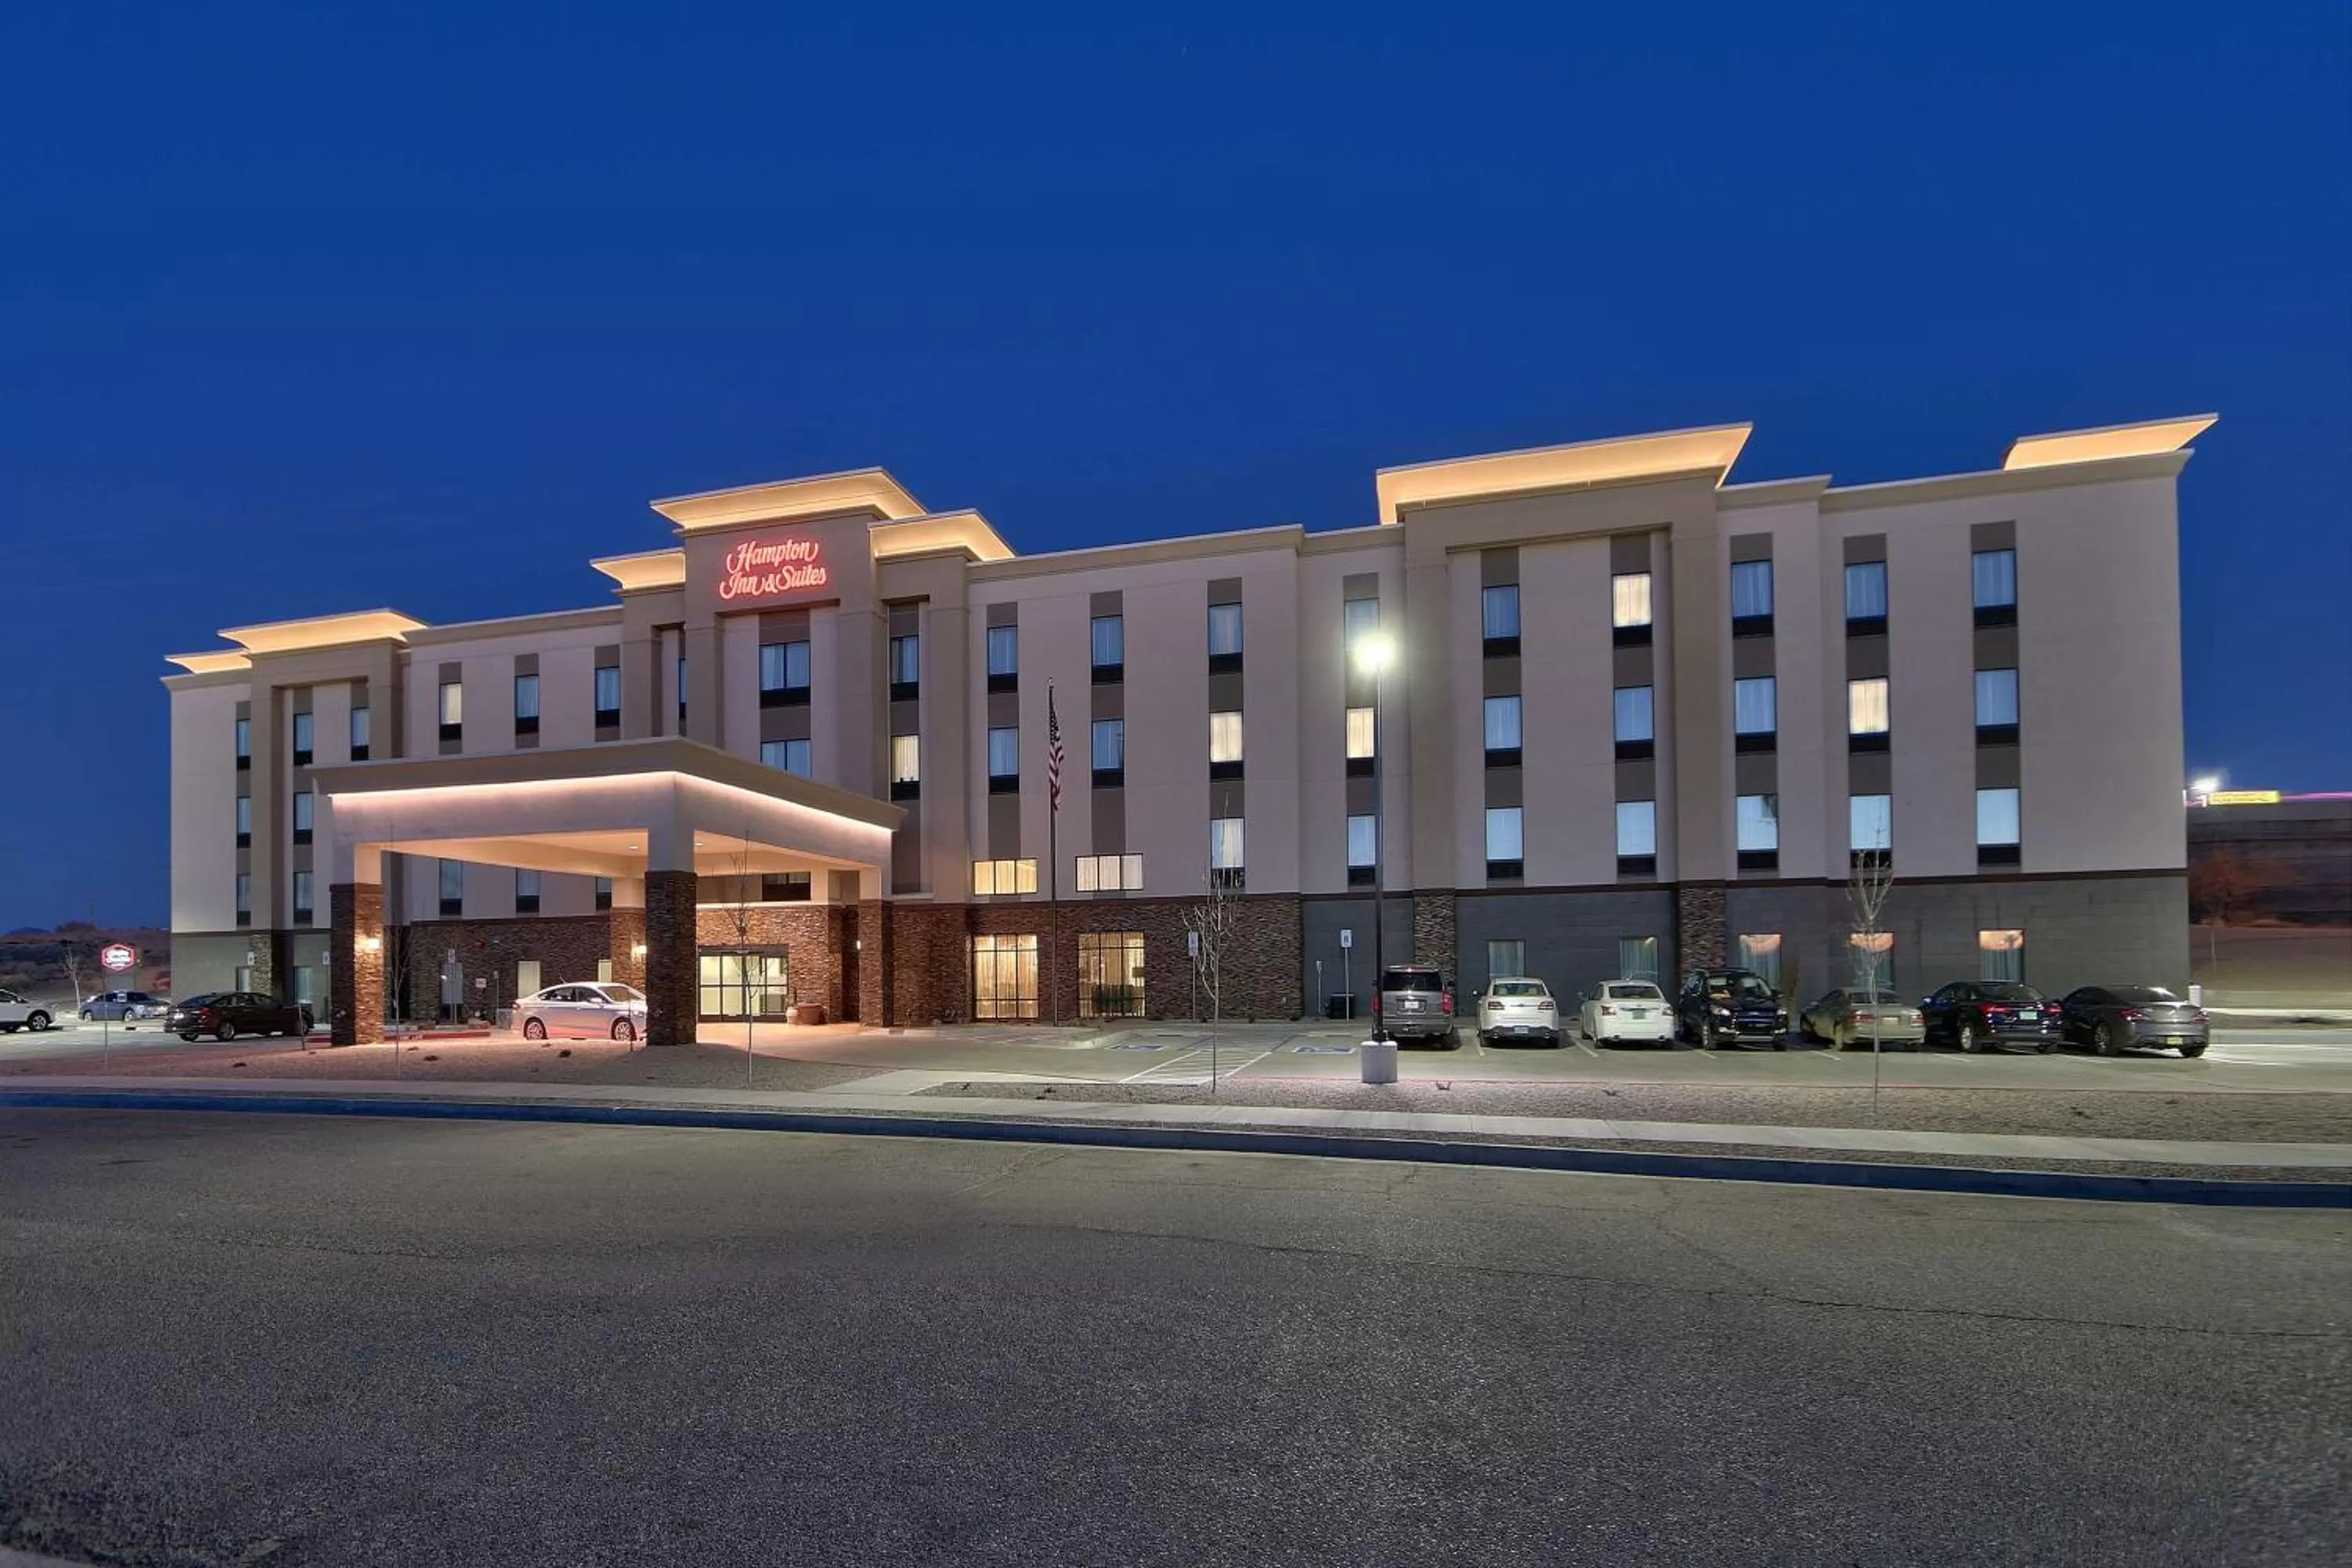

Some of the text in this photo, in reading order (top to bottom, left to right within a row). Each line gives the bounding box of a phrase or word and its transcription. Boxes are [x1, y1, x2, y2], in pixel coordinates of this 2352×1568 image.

[726, 539, 818, 574] Hampton
[719, 564, 827, 599] Inn & Suites
